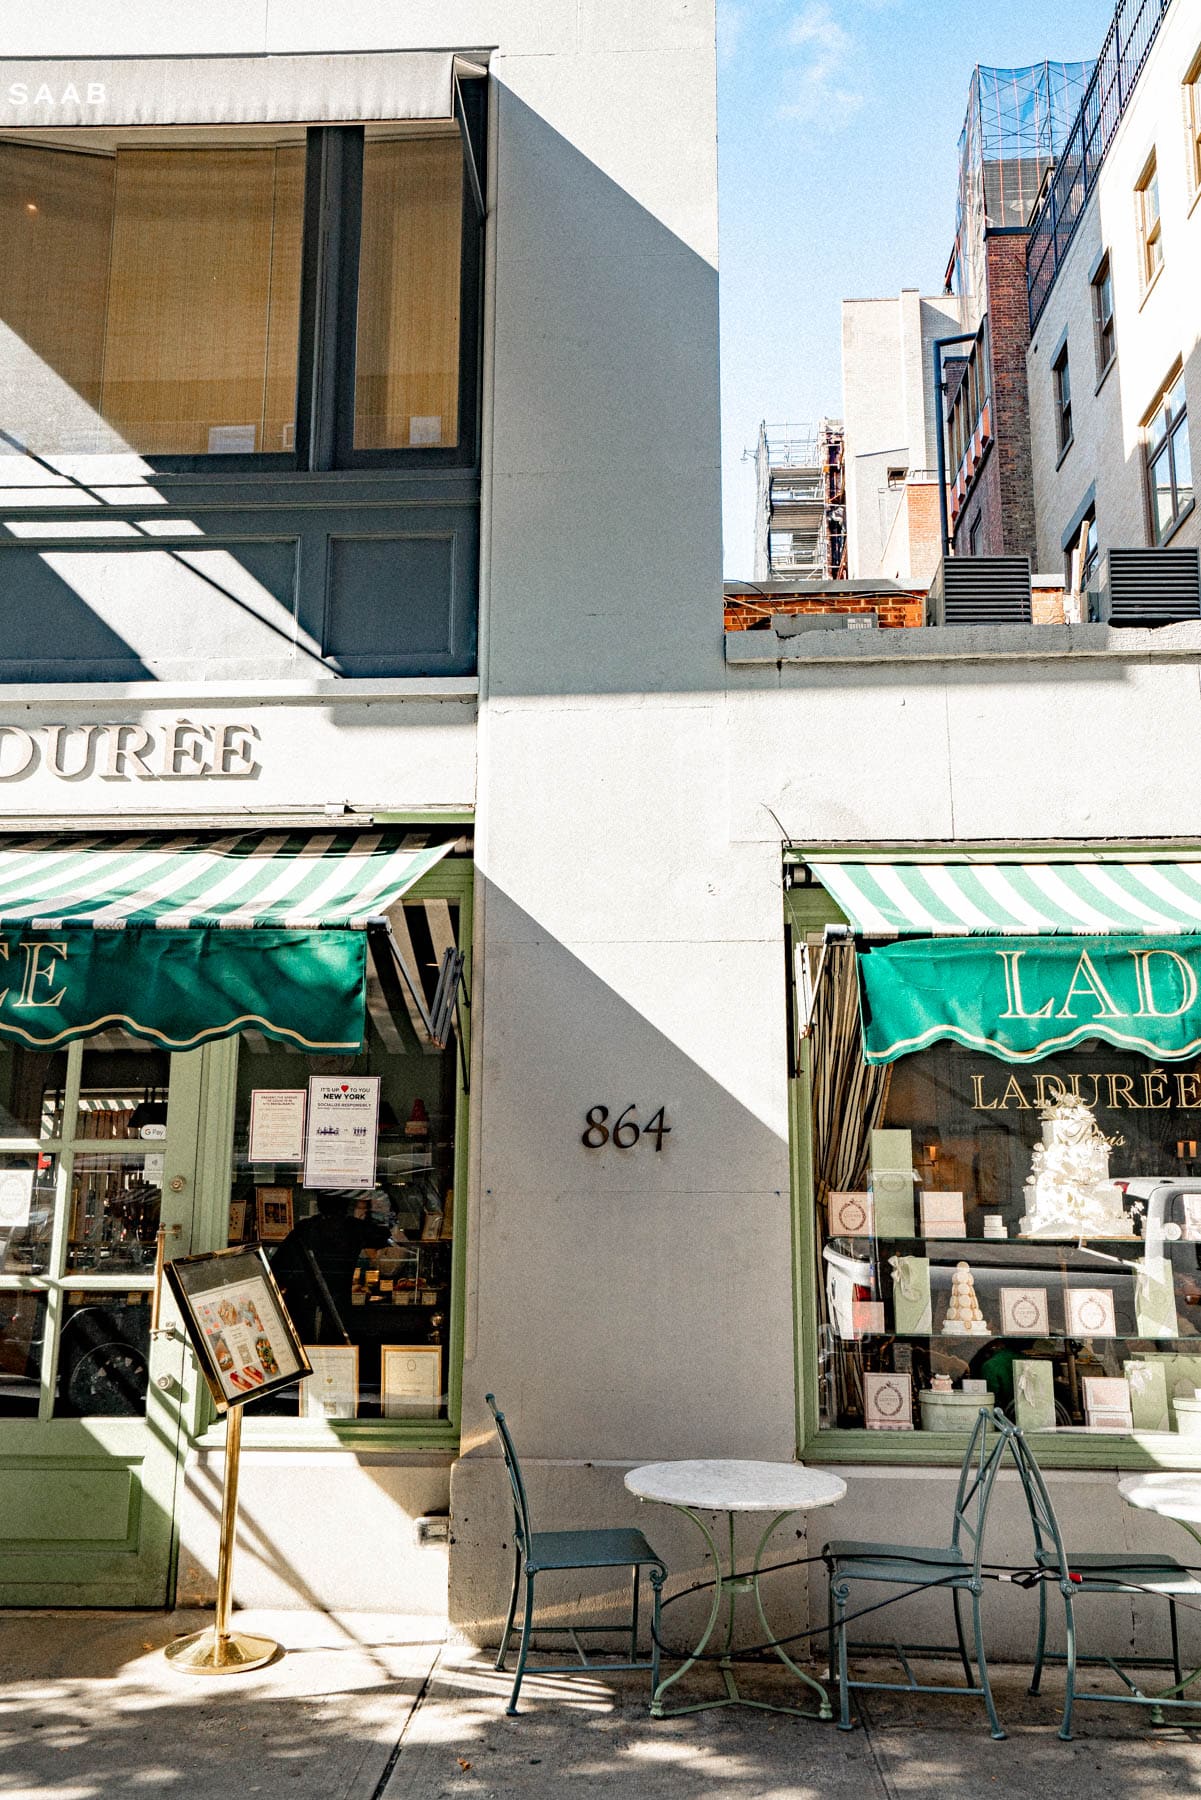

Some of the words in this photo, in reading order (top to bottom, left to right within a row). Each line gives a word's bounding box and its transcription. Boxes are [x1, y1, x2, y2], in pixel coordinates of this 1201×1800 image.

[8, 82, 106, 105] SAAB
[996, 949, 1198, 1018] LAD
[970, 1069, 1201, 1109] LADURÉE
[582, 1104, 672, 1152] 864
